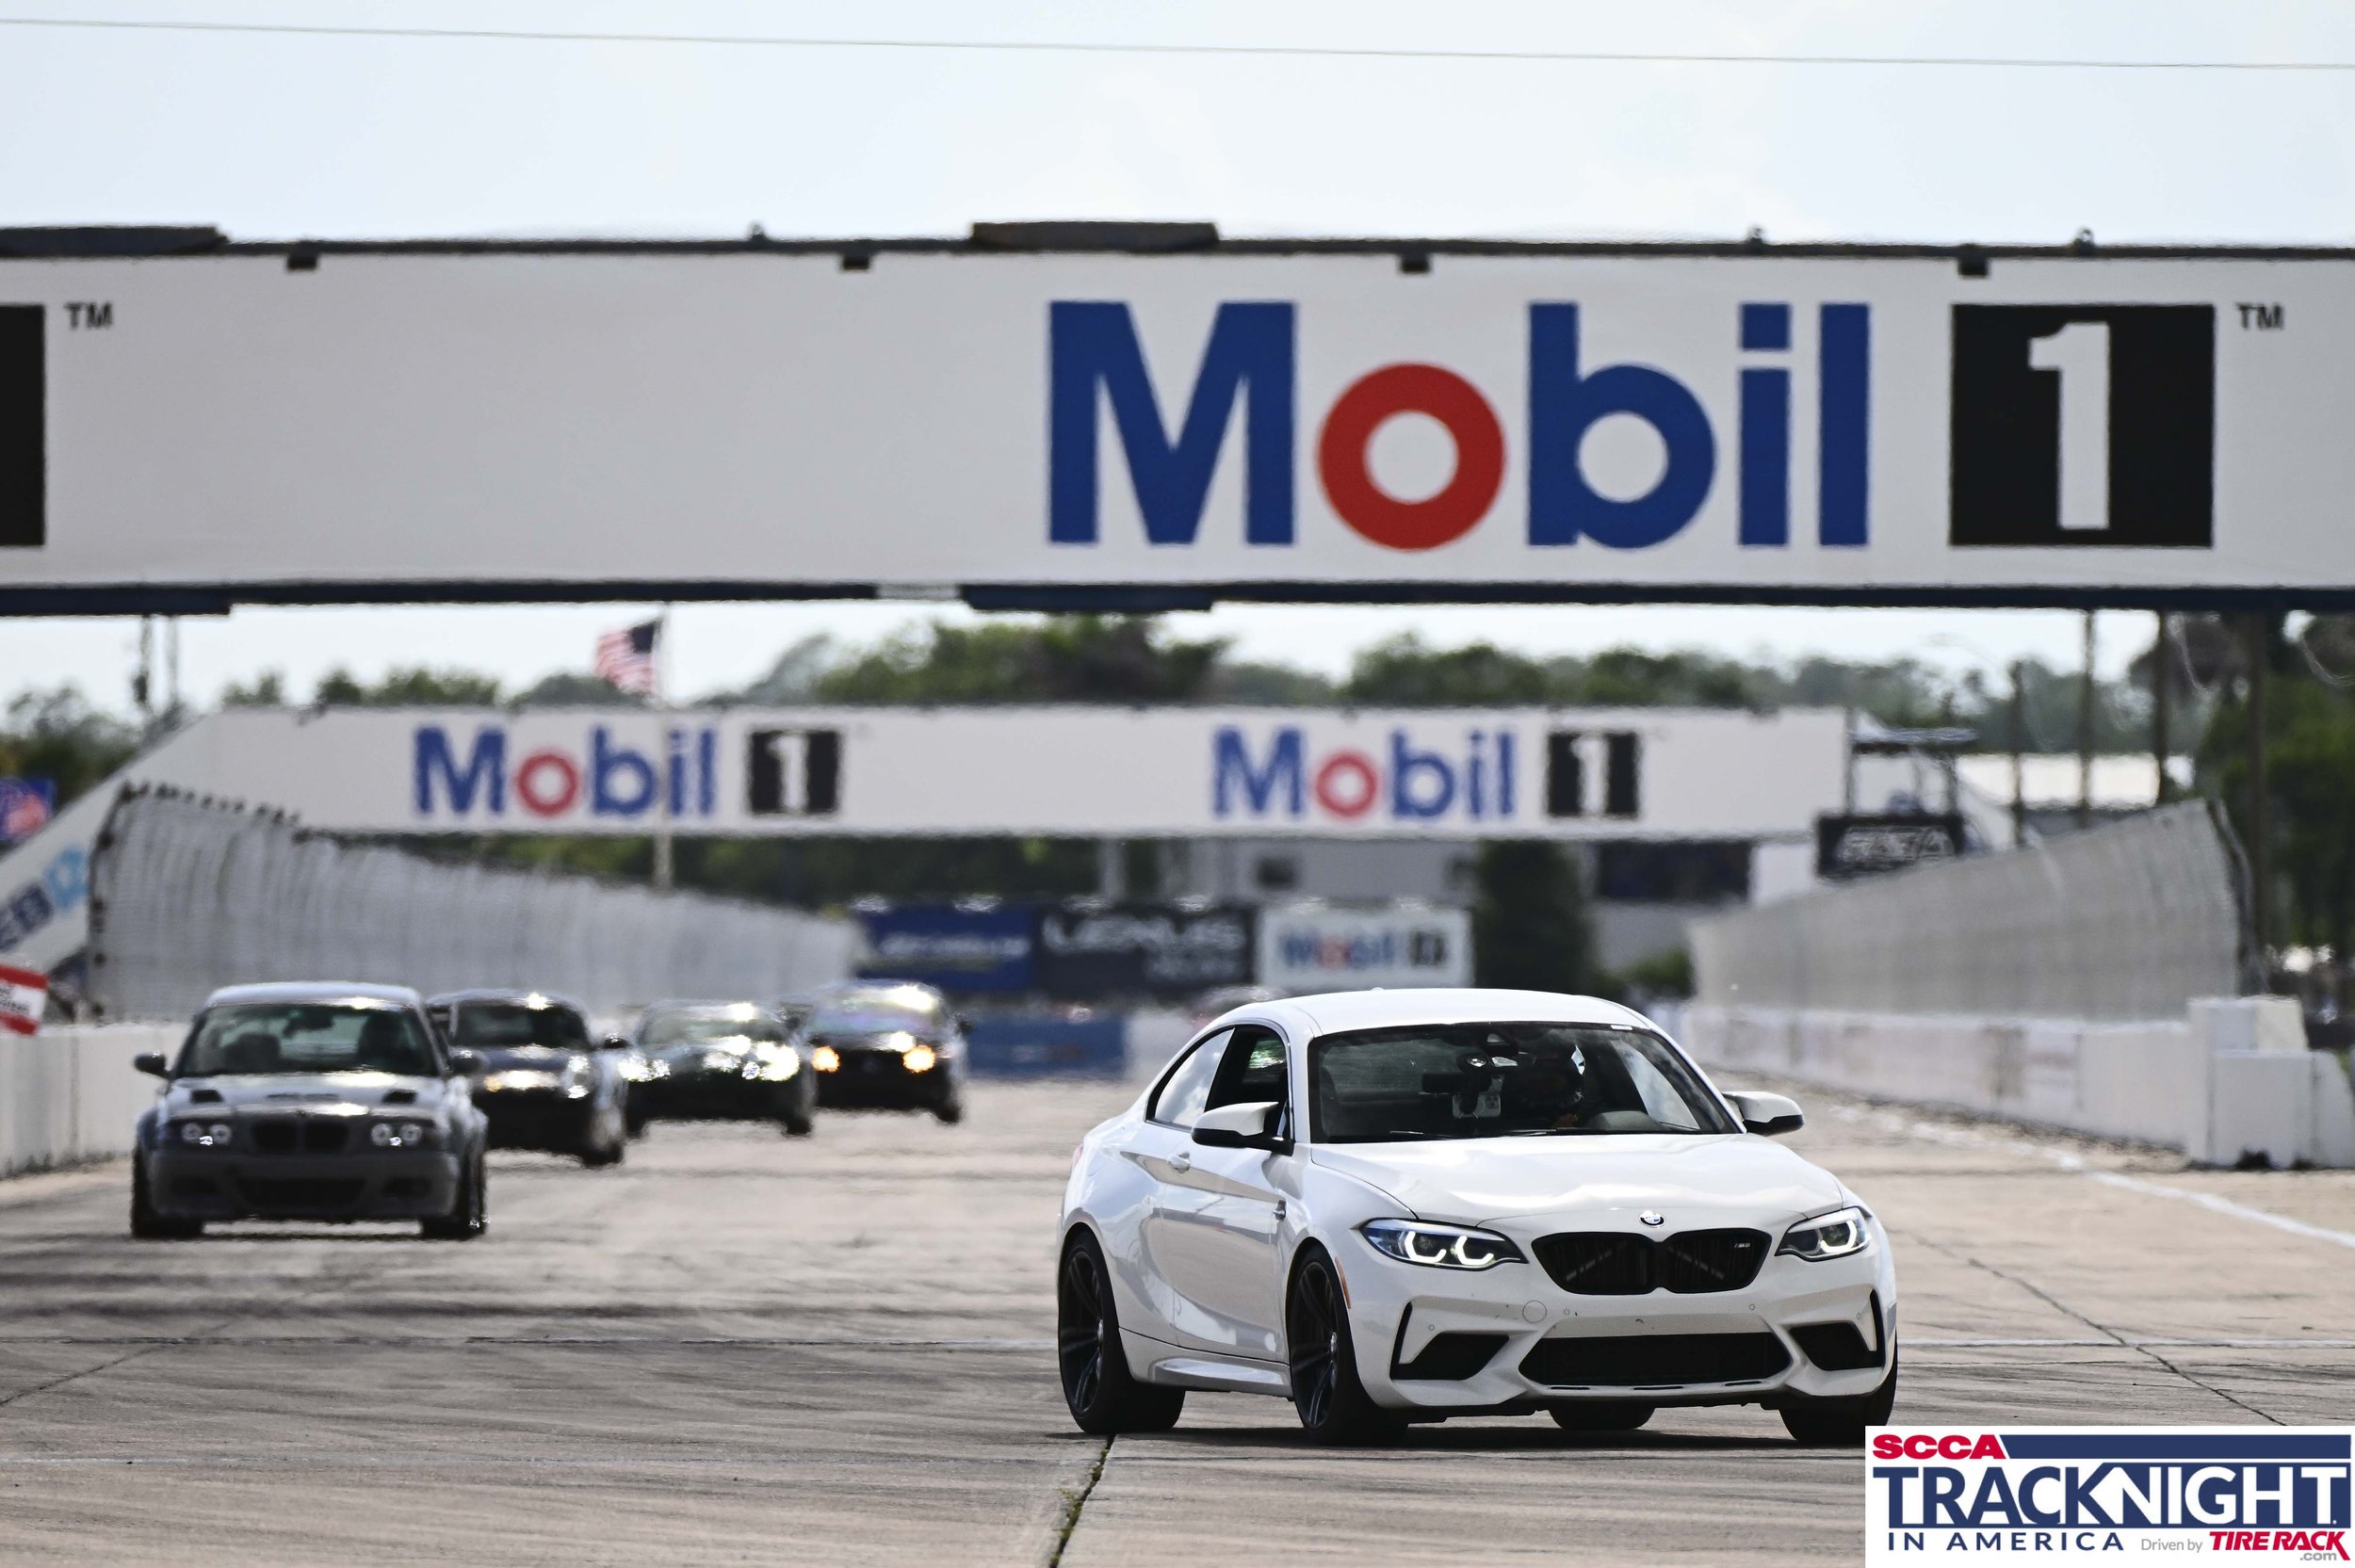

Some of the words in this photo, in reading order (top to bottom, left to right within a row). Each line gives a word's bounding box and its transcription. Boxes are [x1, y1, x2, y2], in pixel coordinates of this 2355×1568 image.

[63, 301, 113, 331] TM
[1047, 300, 1872, 552] Mobil
[2026, 320, 2111, 530] 1
[2235, 302, 2283, 331] TM
[412, 723, 722, 819] Mobil
[1212, 724, 1519, 820] Mobil
